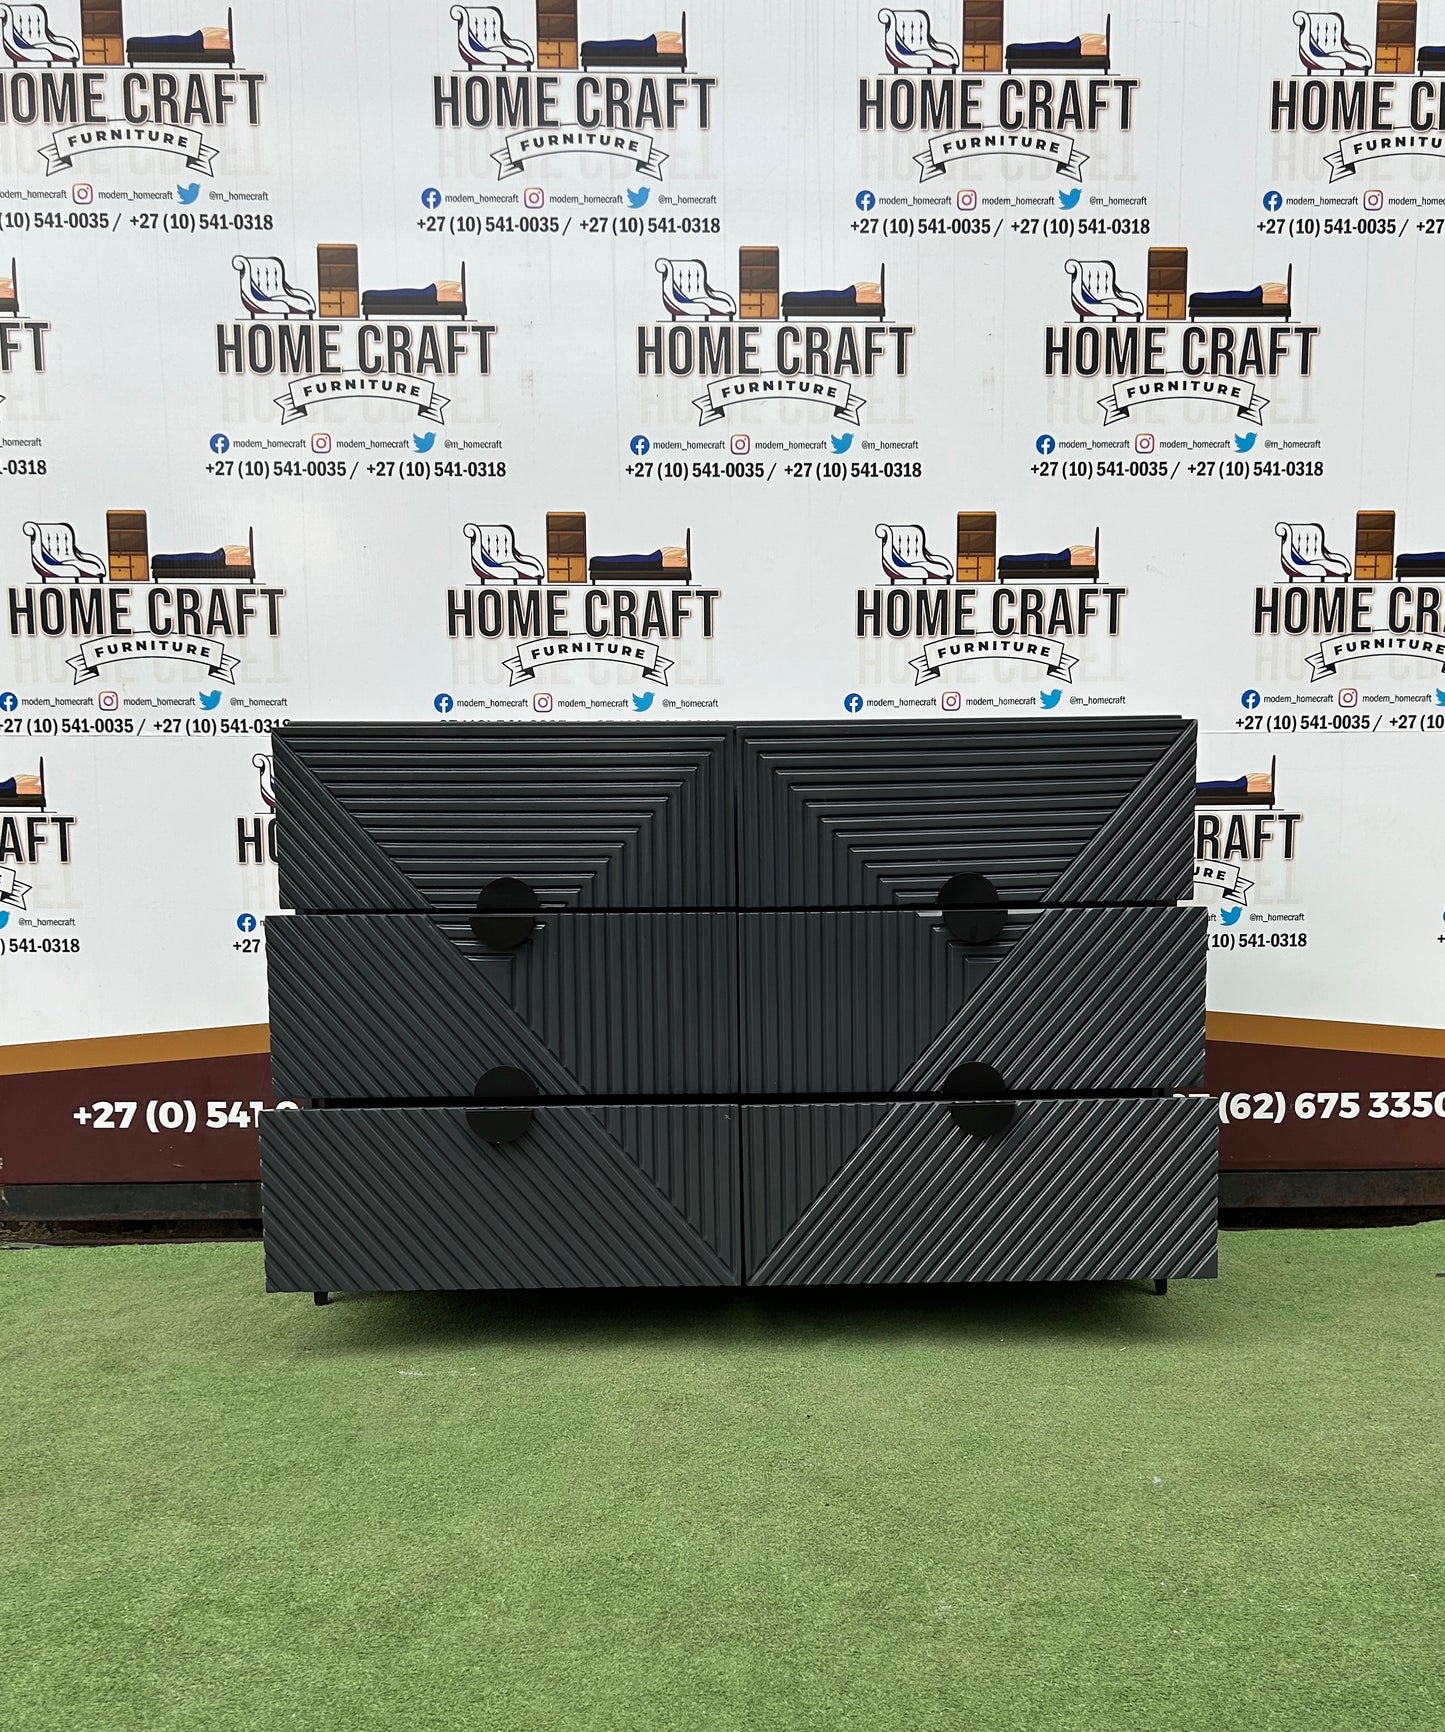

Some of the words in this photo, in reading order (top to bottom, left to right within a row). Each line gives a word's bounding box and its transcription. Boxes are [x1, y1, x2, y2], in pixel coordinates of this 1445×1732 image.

[0, 72, 107, 124] OME
[123, 73, 265, 125] CRAFT
[433, 76, 560, 127] HOME
[576, 77, 715, 129] CRAFT
[859, 79, 982, 130] HOME
[999, 79, 1138, 131] CRAFT
[1271, 80, 1394, 130] HOME
[67, 129, 188, 148] FURNITURE
[520, 133, 638, 152] FURNITURE
[943, 136, 1060, 154] FURNITURE
[1354, 136, 1442, 154] FURNITU
[209, 190, 268, 202] @m_homecraft
[658, 194, 716, 206] @m_homecraft
[1089, 195, 1147, 207] @m_homecraft
[34, 212, 109, 228] 541-0035
[130, 213, 158, 229] +27
[163, 213, 195, 233] (10)
[199, 214, 273, 230] 541-0318
[417, 216, 445, 231] +27
[450, 216, 481, 235] (10)
[486, 216, 559, 232] 541-0035
[580, 217, 608, 232] +27
[612, 217, 644, 236] (10)
[648, 217, 720, 233] 541-0318
[851, 218, 879, 233] +27
[883, 218, 914, 237] (10)
[918, 218, 990, 234] 541-0035
[1011, 219, 1039, 234] +27
[1043, 219, 1074, 238] (10)
[1078, 219, 1150, 234] 541-0318
[1257, 219, 1285, 234] +27
[1289, 219, 1320, 238] (10)
[1324, 219, 1396, 234] 541-0035
[1416, 219, 1445, 234] +27
[217, 324, 341, 374] HOME
[358, 325, 496, 375] CRAFT
[637, 326, 764, 375] HOME
[776, 326, 914, 376] CRAFT
[1045, 327, 1164, 375] HOME
[1181, 326, 1319, 376] CRAFT
[303, 379, 420, 397] FURNITURE
[721, 380, 837, 398] FURNITURE
[1127, 381, 1241, 398] FURNITURE
[0, 437, 42, 448] _homecraft
[444, 439, 502, 450] @m_homecraft
[861, 439, 918, 451] @m_homecraft
[1265, 439, 1321, 450] @m_homecraft
[0, 460, 47, 475] -0318
[206, 461, 234, 476] +27
[238, 461, 269, 479] (10)
[273, 461, 346, 476] 541-0035
[367, 461, 395, 476] +27
[399, 461, 430, 480] (10)
[434, 462, 506, 477] 541-0318
[625, 462, 653, 477] +27
[658, 462, 688, 481] (10)
[692, 462, 764, 478] 541-0035
[784, 462, 812, 477] +27
[816, 462, 847, 481] (10)
[851, 462, 921, 477] 541-0318
[1031, 462, 1058, 476] +27
[1062, 461, 1093, 480] (10)
[1097, 461, 1167, 476] 541-0035
[1188, 461, 1215, 476] +27
[1219, 461, 1249, 480] (10)
[1253, 461, 1323, 476] 541-0318
[9, 587, 132, 635] HOME
[147, 588, 285, 636] CRAFT
[448, 589, 568, 637] HOME
[584, 590, 720, 637] CRAFT
[856, 588, 975, 636] HOME
[992, 588, 1126, 635] CRAFT
[1254, 587, 1373, 634] HOME
[94, 640, 210, 658] FURNITURE
[531, 642, 645, 659] FURNITURE
[937, 641, 1050, 658] FURNITURE
[230, 696, 288, 707] @m_homecraft
[662, 698, 718, 709] @m_homecraft
[1070, 695, 1126, 706] @m_homecraft
[27, 718, 58, 736] (10)
[62, 718, 134, 733] 541-0035
[154, 718, 181, 733] +27
[186, 718, 217, 736] (10)
[1236, 715, 1263, 730] +27
[1267, 715, 1296, 732] (10)
[1300, 715, 1370, 730] 541-0035
[1389, 715, 1417, 730] +27
[1420, 715, 1445, 732] (10
[0, 817, 75, 862] AFT
[1197, 814, 1301, 859] RAFT
[18, 917, 76, 927] @m_homecraft
[1249, 912, 1304, 923] @m_homecraft
[9, 938, 80, 953] 541-0318
[233, 939, 260, 953] +27
[1238, 933, 1307, 947] 541-0318
[73, 1101, 138, 1129] +27
[146, 1100, 196, 1133] (0)
[1219, 1092, 1286, 1124] (62)
[1294, 1092, 1360, 1119] 675
